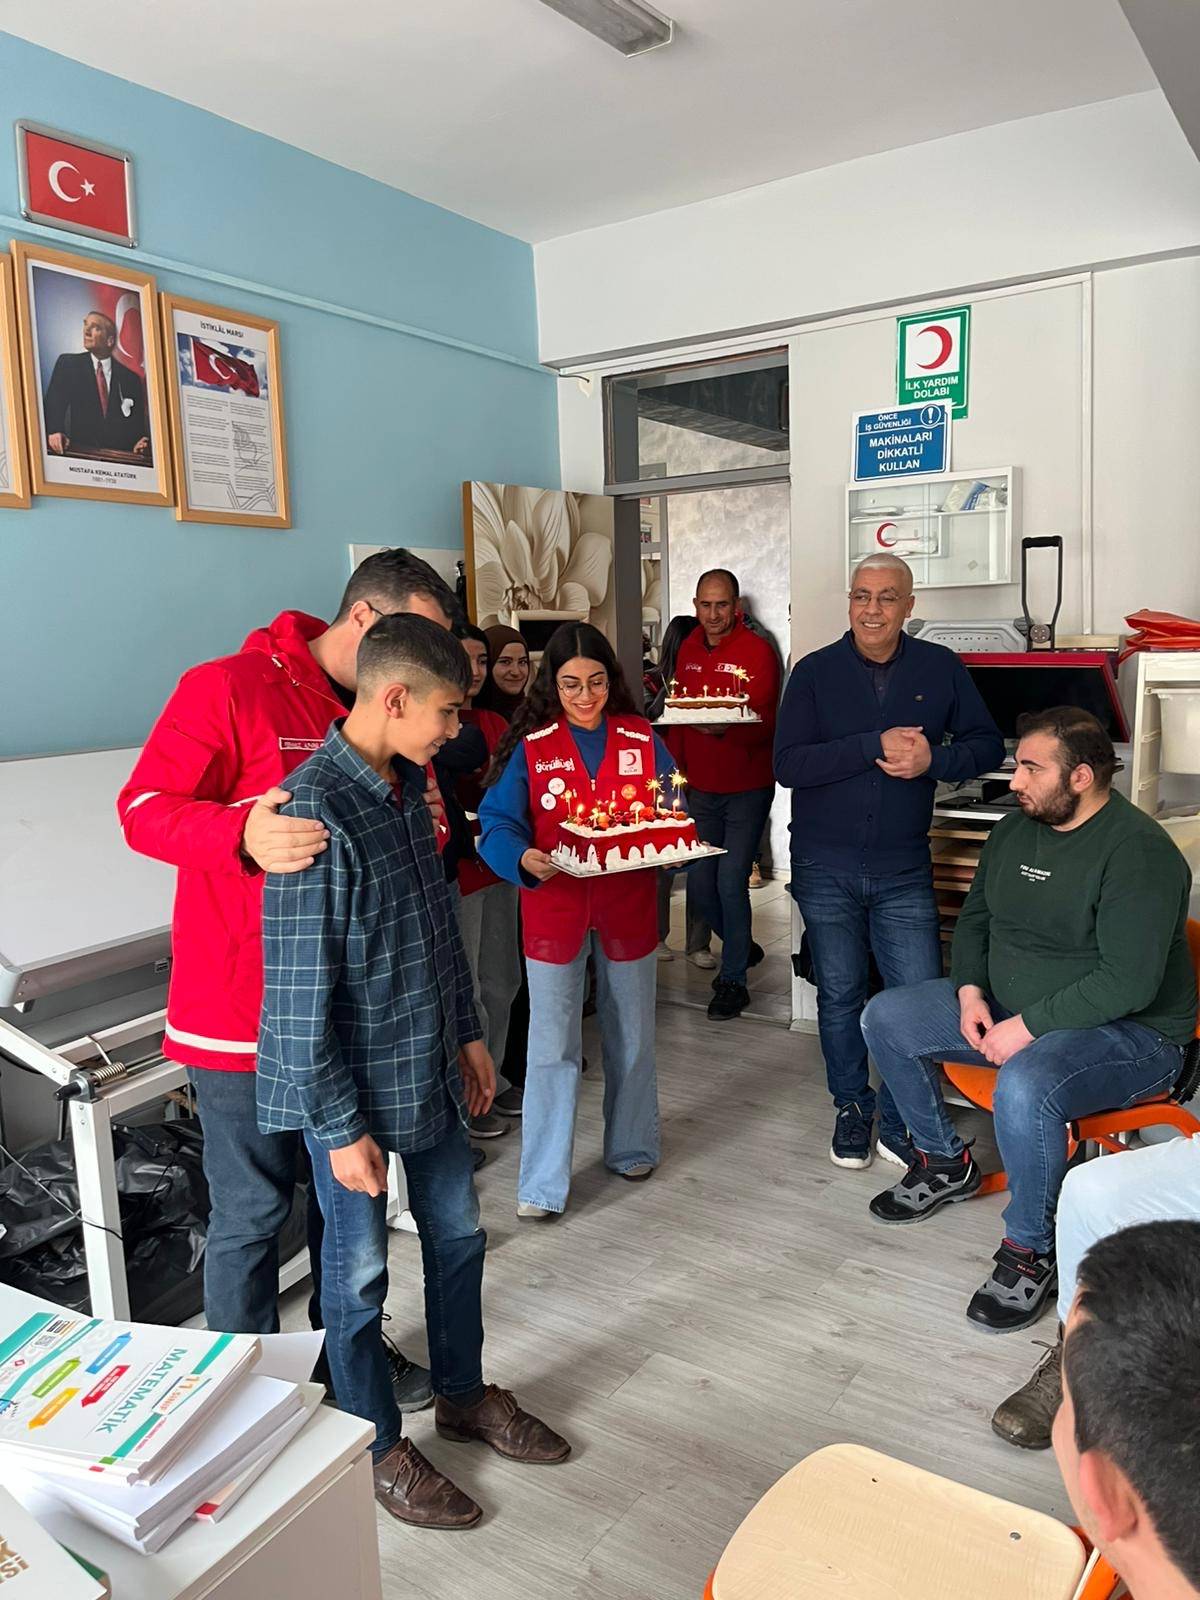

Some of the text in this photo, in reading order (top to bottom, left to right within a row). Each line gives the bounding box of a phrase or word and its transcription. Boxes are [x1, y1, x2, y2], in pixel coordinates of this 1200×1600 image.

[905, 376, 959, 390] İLK YARDIM
[913, 387, 950, 399] DOLABI
[878, 412, 898, 420] ÖNCE
[865, 418, 912, 432] İŞ GÜVENLİĞİ
[869, 431, 933, 448] MAKİNALARI
[877, 443, 923, 459] DİKKATLİ
[879, 459, 920, 472] KULLAN
[69, 466, 137, 480] MUSTAFA KEMAL ATATÜRK
[95, 1348, 187, 1434] MATEMATİK
